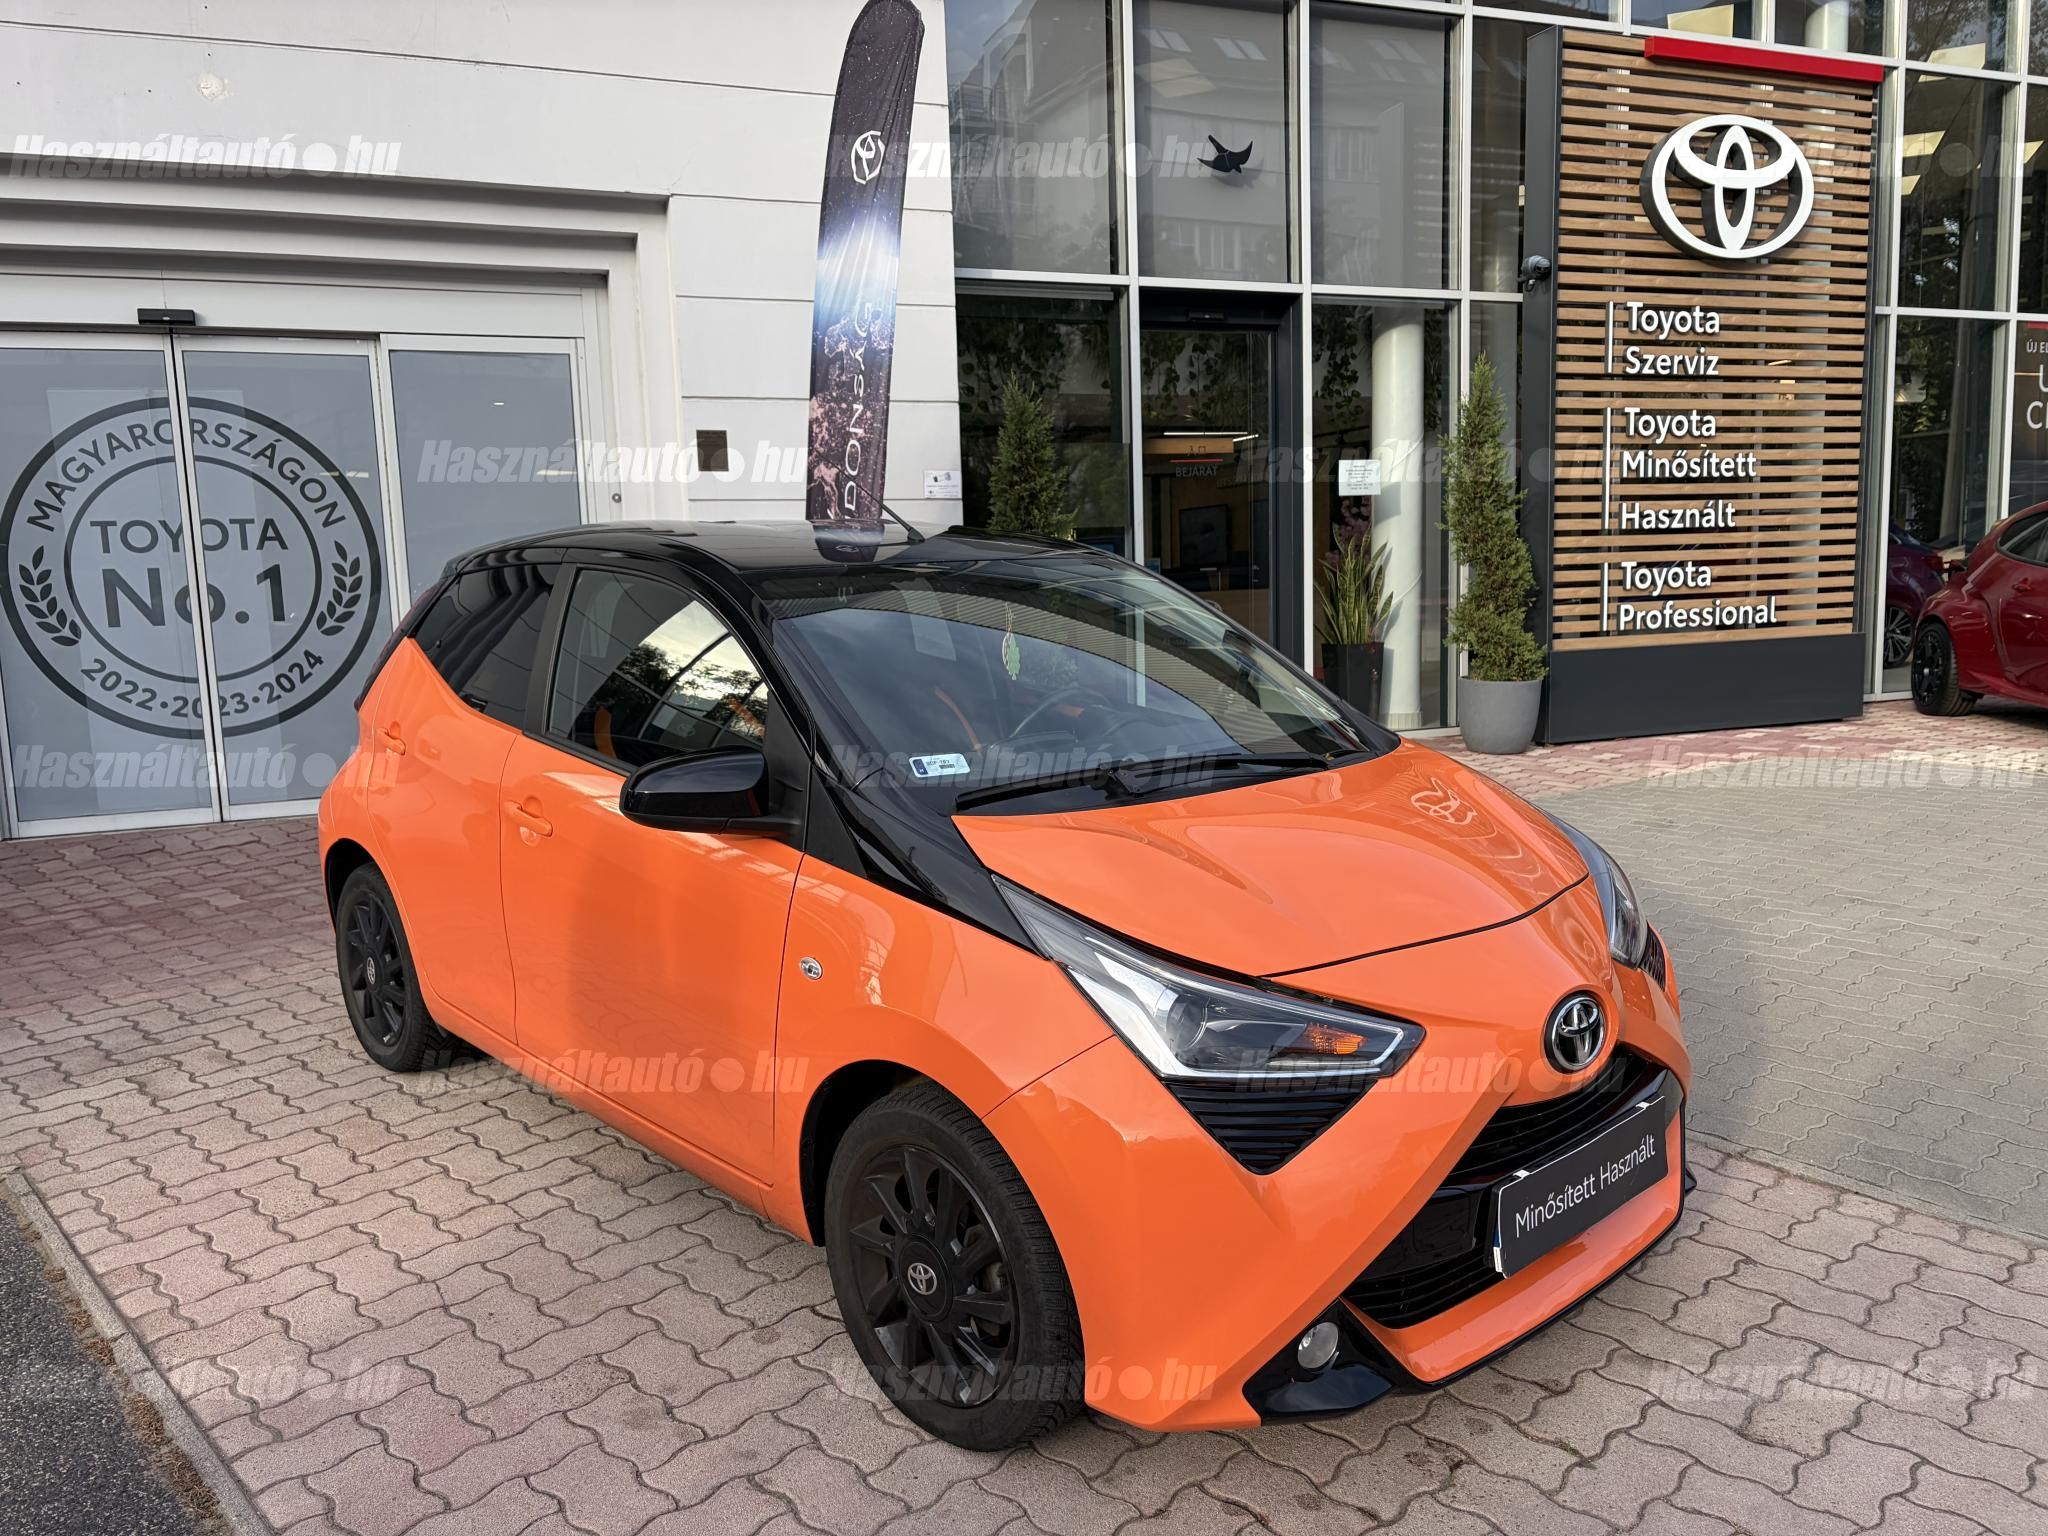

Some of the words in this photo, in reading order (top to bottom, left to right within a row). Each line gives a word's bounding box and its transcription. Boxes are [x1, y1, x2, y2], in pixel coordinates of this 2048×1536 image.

[1627, 301, 1720, 340] Toyota
[1625, 346, 1719, 375] Szerviz
[1624, 407, 1716, 444] Toyota
[27, 418, 346, 532] MAGYARORSZÁGON
[1621, 449, 1757, 478] Minősített
[1621, 499, 1736, 529] Használt
[90, 518, 288, 554] TOYOTA
[1621, 561, 1712, 596] Toyota
[1619, 595, 1777, 631] Professional
[1515, 1173, 1597, 1239] Minősített
[1600, 1134, 1656, 1190] Használt
